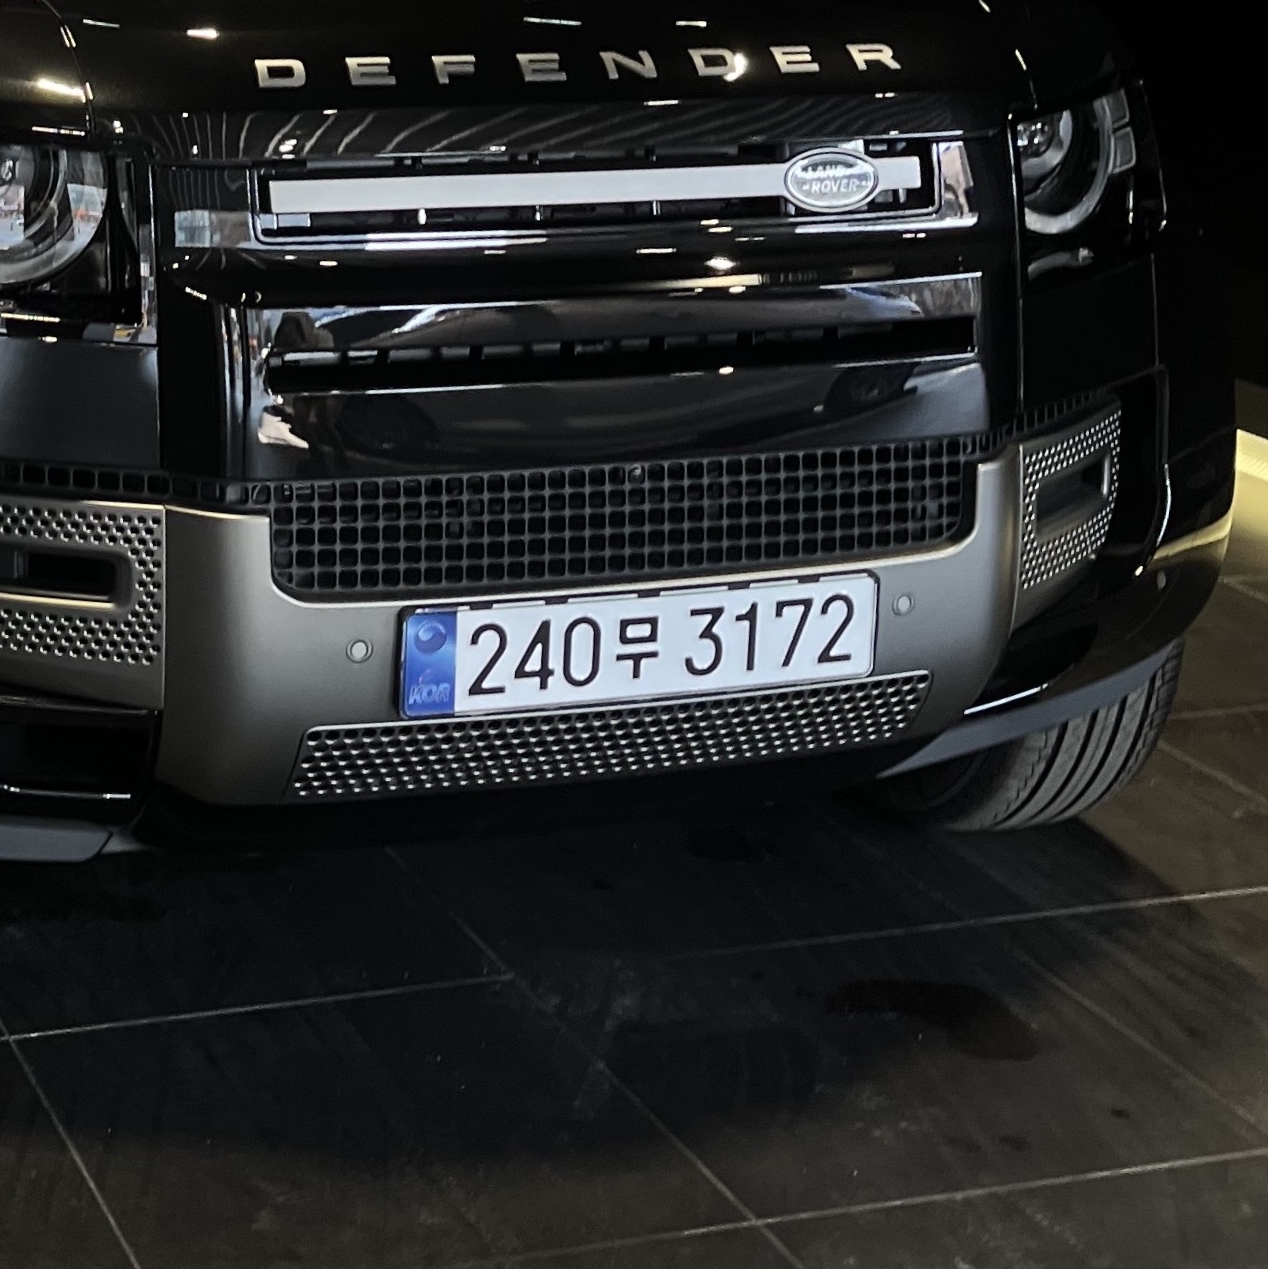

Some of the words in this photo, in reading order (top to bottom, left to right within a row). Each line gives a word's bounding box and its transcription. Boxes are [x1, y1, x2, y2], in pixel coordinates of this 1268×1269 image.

[255, 43, 901, 87] DEFENDER
[811, 178, 858, 193] ROVER
[469, 616, 660, 696] 240무
[685, 593, 856, 676] 3172
[408, 682, 451, 705] KOR
